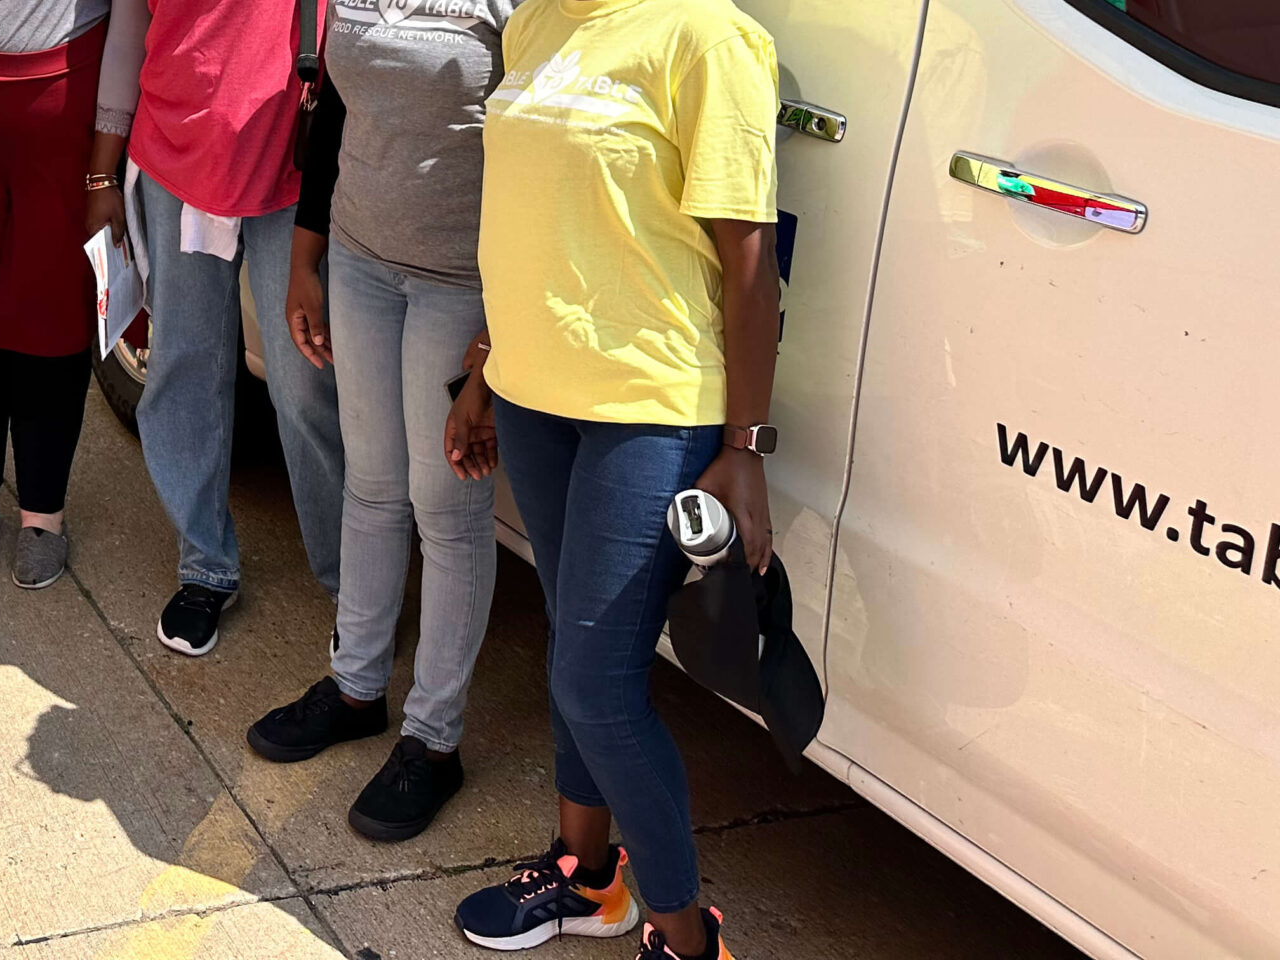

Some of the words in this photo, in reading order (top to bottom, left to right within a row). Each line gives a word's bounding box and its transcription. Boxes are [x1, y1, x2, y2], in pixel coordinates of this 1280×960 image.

[333, 21, 351, 34] FOOD
[352, 24, 397, 39] RESCUE
[398, 29, 464, 45] NETWORK
[505, 71, 531, 86] BLE
[573, 75, 643, 104] TABLE
